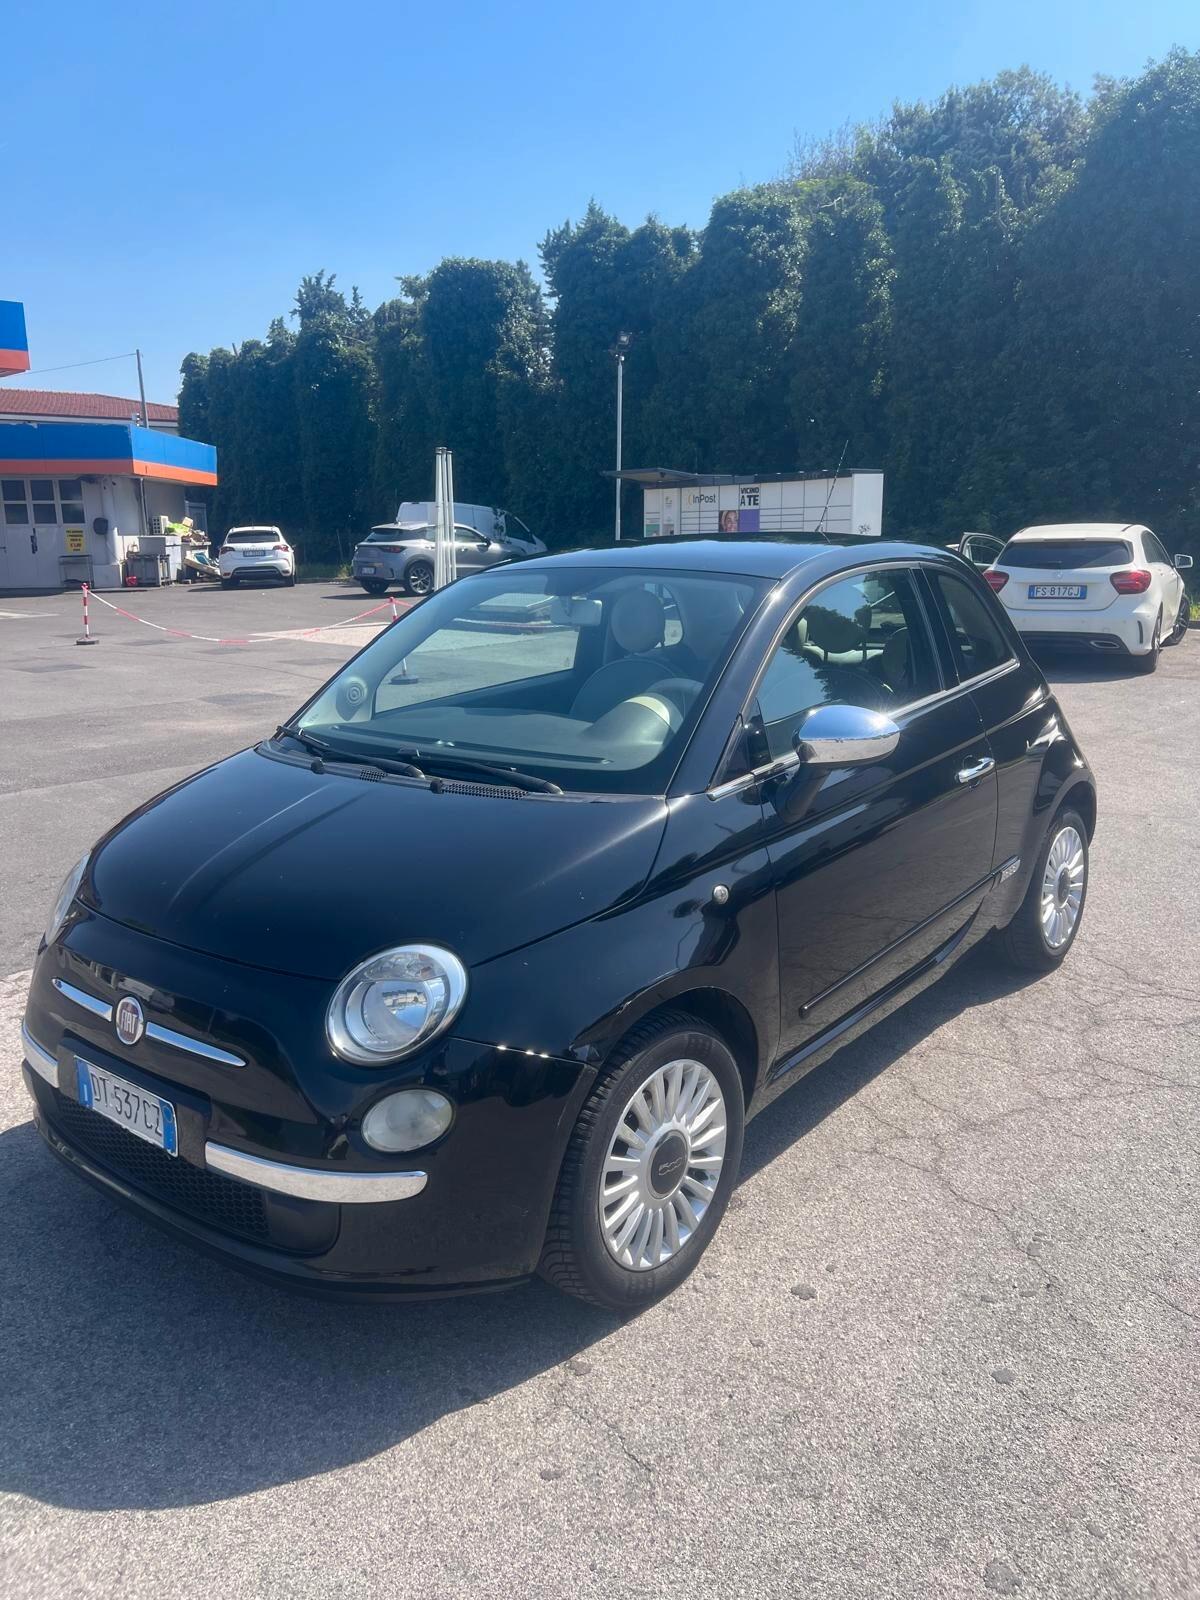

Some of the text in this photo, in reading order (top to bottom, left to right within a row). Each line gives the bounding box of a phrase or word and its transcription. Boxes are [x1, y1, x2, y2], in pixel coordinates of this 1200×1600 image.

[693, 494, 716, 503] InPost
[741, 495, 759, 506] A TE
[1035, 586, 1047, 596] FS
[121, 1009, 138, 1034] FIAT
[91, 1073, 162, 1136] DT 537CZ
